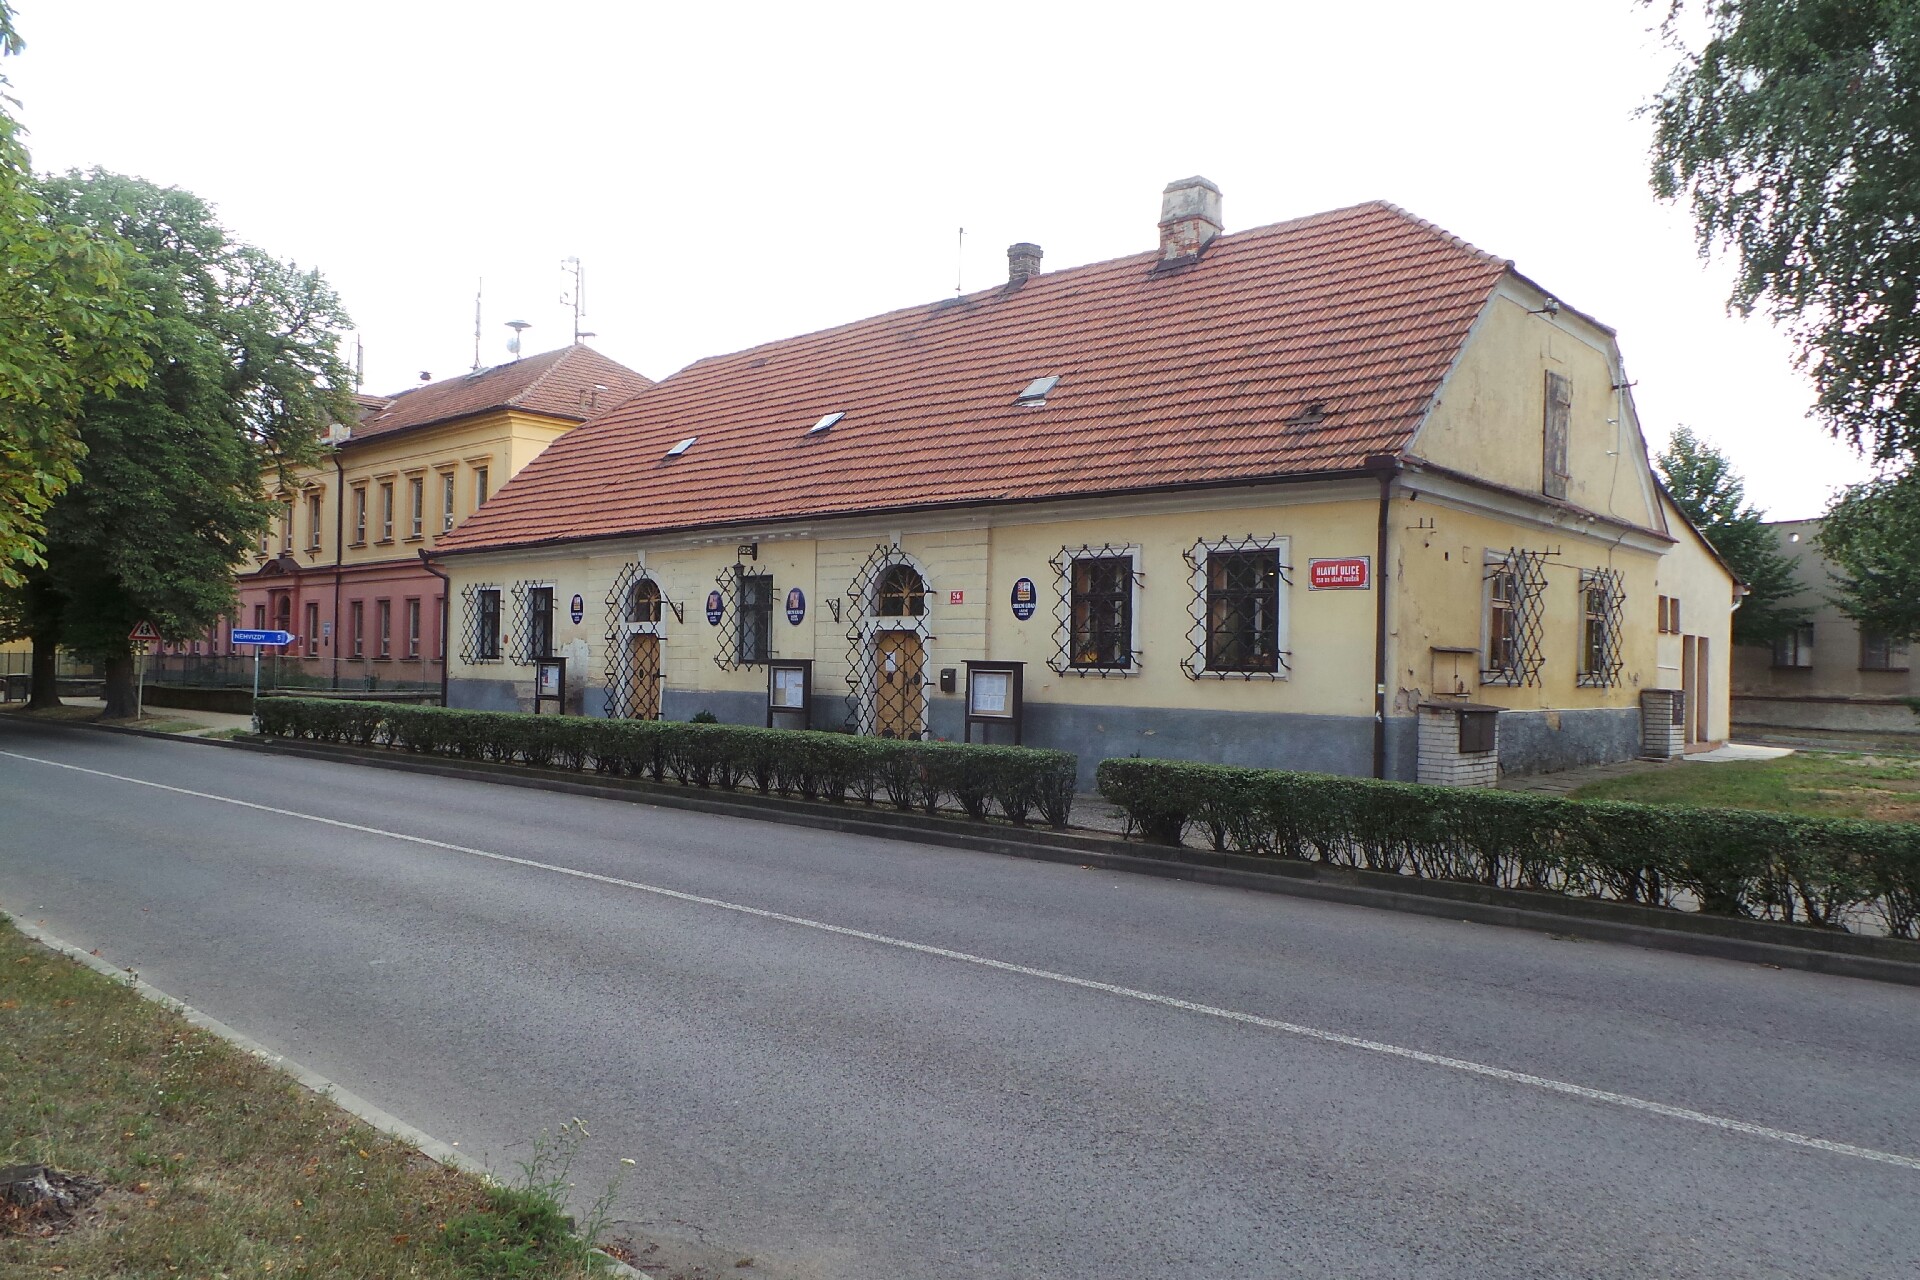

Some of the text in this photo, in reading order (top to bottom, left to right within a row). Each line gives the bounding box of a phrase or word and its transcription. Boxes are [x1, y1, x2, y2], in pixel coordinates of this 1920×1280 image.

[1316, 564, 1360, 576] HLAVNÍ ULICE
[952, 592, 961, 600] 56
